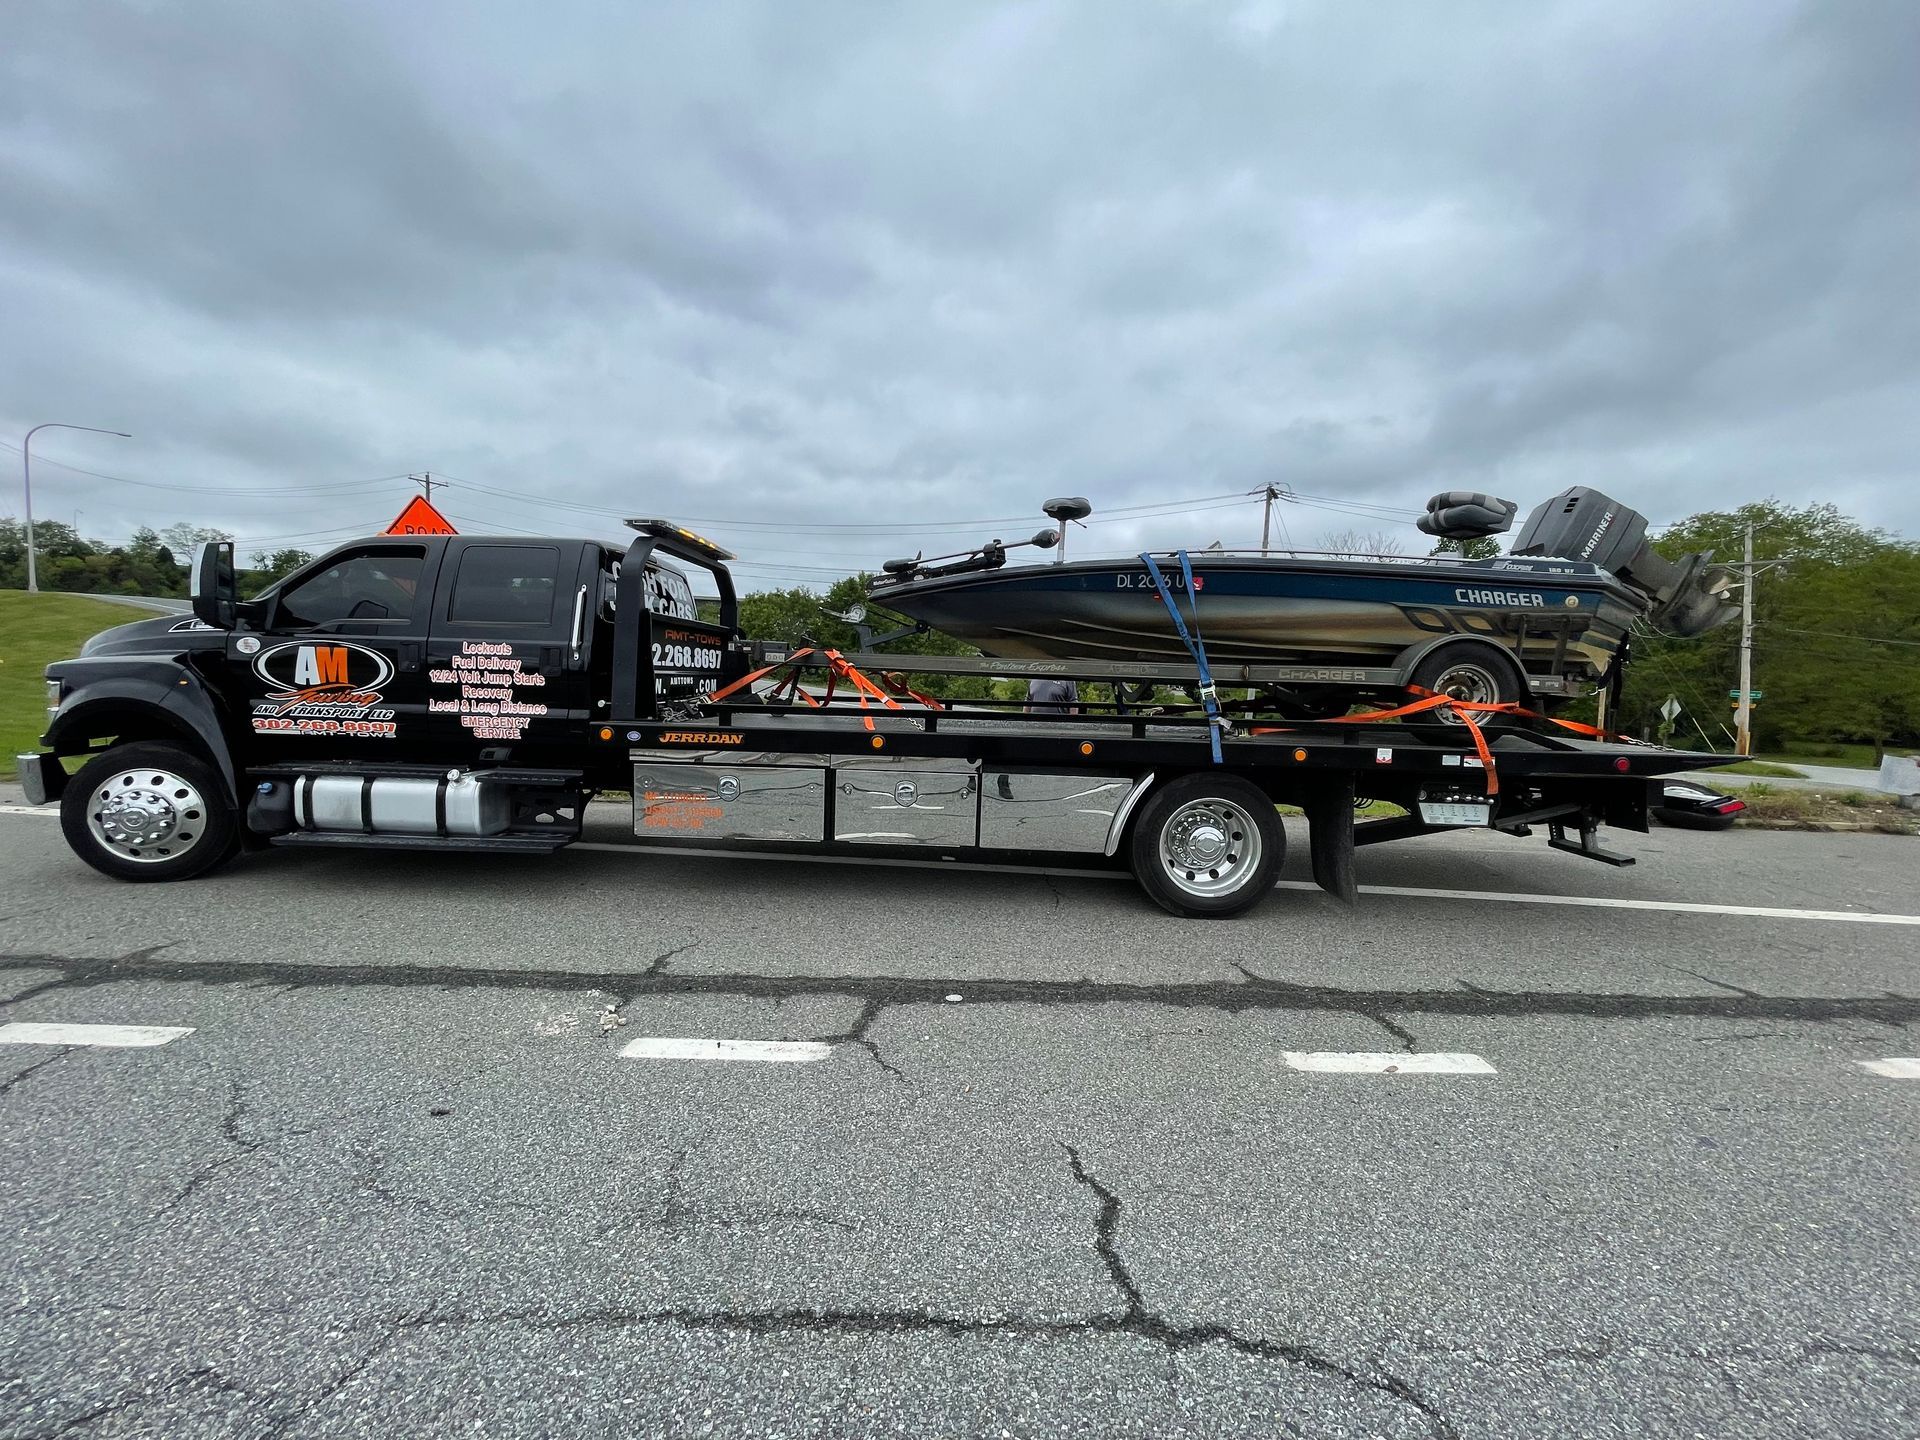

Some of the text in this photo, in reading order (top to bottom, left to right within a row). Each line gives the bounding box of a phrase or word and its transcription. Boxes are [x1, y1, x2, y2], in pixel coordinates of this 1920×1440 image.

[1580, 511, 1614, 559] MARINER
[660, 576, 687, 601] FOR
[1117, 574, 1185, 588] DL 206 U
[1455, 588, 1545, 608] CHARGER
[659, 600, 694, 620] CARS
[665, 629, 722, 646] AMT-TOWS
[462, 642, 512, 656] Lockouts
[652, 643, 722, 669] 2.268.8697
[294, 646, 349, 685] AM
[452, 656, 522, 671] Fuel Delivery
[429, 670, 545, 687] 12/24 Volt Jump Starts
[1279, 669, 1366, 681] CHARGER
[265, 684, 383, 715] Towing
[462, 685, 513, 700] Recovery
[252, 705, 395, 720] AND TRANSPORT LLC
[429, 699, 547, 715] Local & Long Distance
[252, 718, 397, 734] 302.268.8697
[461, 716, 530, 729] EMERGENCY
[473, 728, 521, 739] SERVICE
